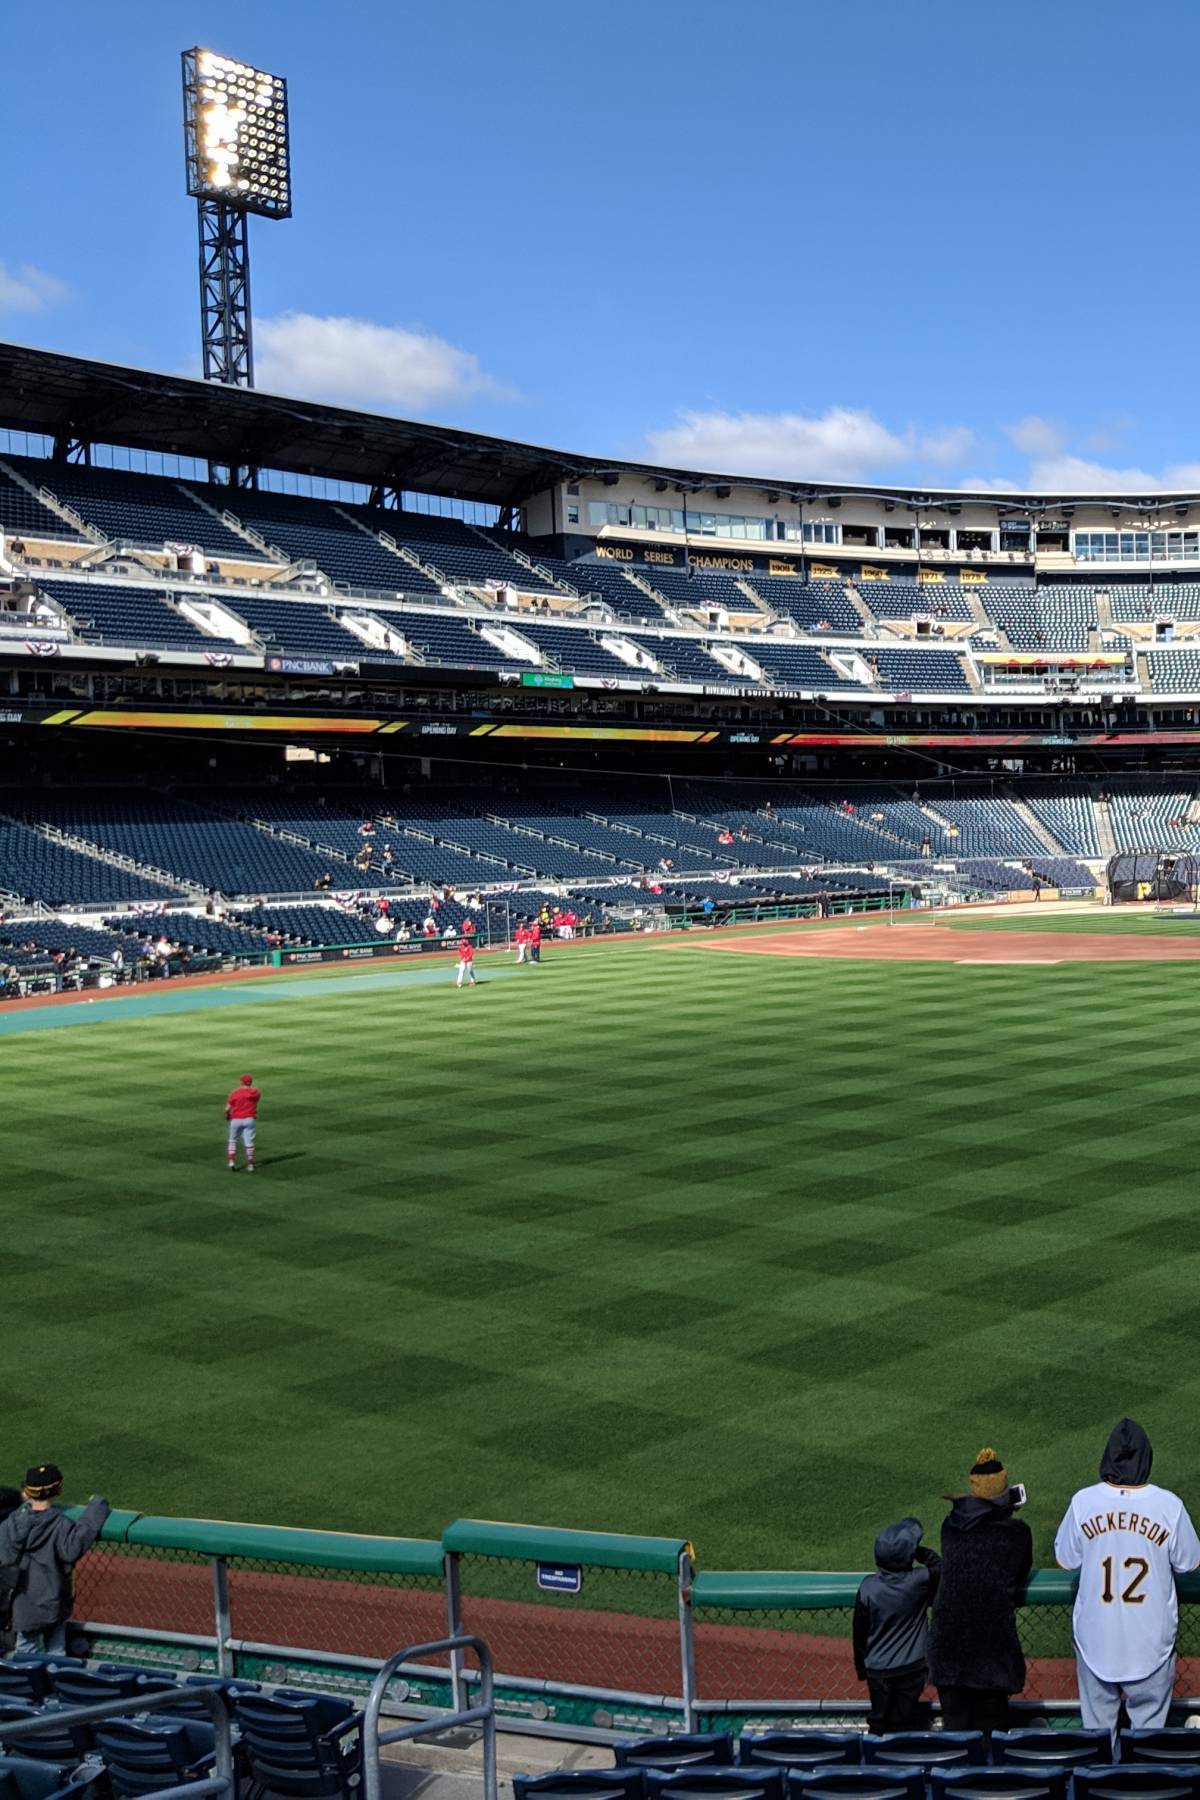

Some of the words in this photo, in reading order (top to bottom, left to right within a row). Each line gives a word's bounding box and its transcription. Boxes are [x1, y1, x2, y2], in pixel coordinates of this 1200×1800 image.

[596, 547, 634, 560] WORLD
[644, 551, 674, 564] SERIES
[688, 555, 753, 570] CHAMPIONS
[813, 567, 832, 575] 1925
[282, 660, 303, 670] PNC
[303, 661, 329, 672] BANK
[774, 690, 798, 698] LEVEL
[1080, 1511, 1170, 1547] DICKERSON
[1101, 1555, 1149, 1603] 12
